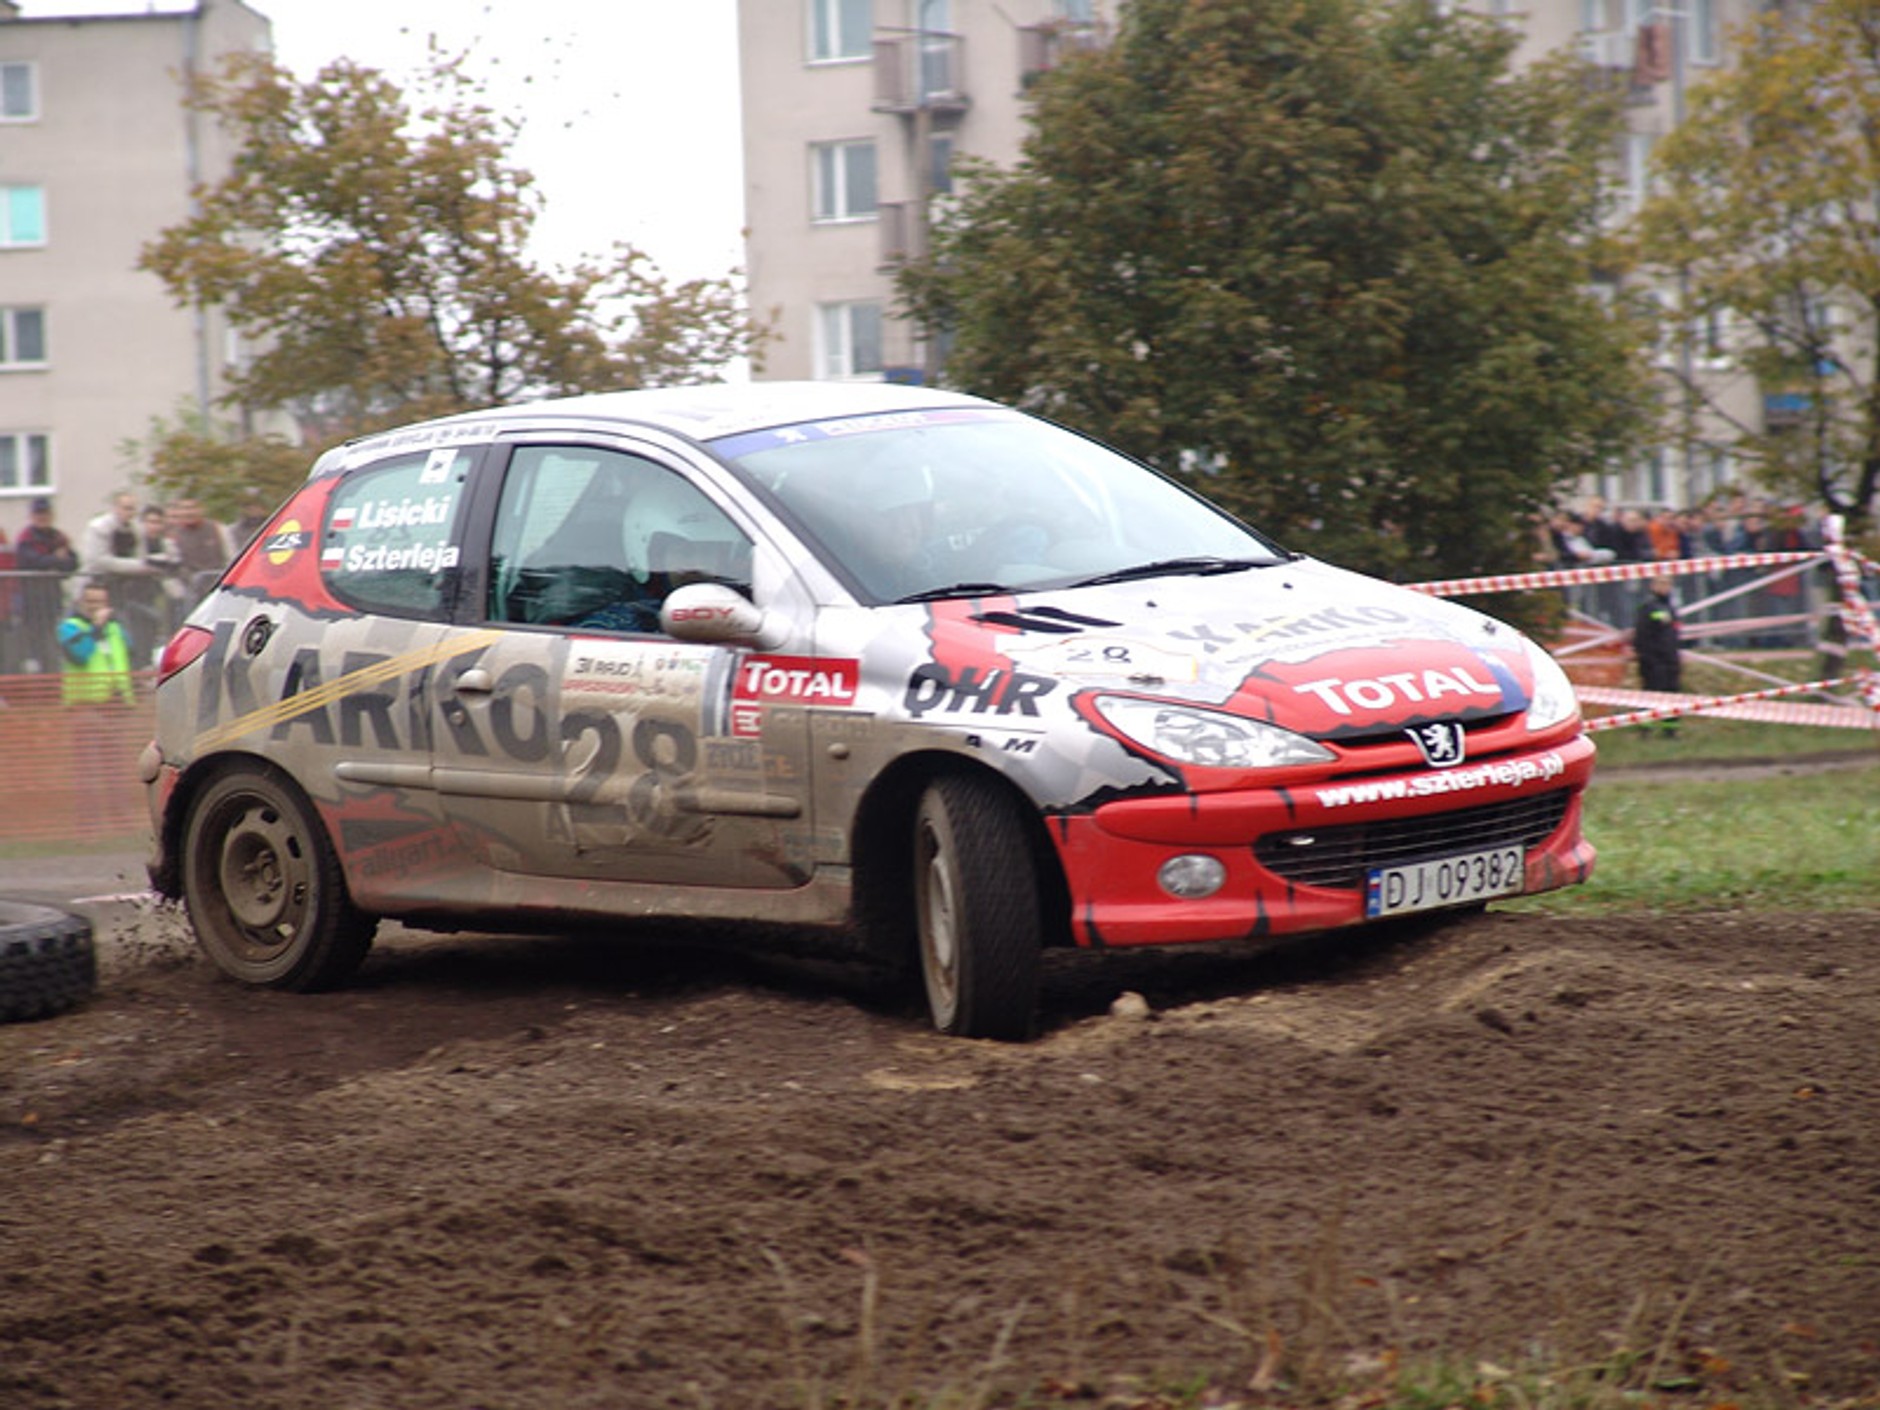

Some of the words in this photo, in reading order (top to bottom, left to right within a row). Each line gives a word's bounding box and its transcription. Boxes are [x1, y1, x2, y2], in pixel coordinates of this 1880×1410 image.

[358, 496, 452, 529] Lisicki
[347, 540, 460, 574] Szterleja
[196, 620, 549, 763] KARKO
[745, 660, 853, 699] TOTAL
[1294, 667, 1503, 716] TOTAL
[560, 706, 712, 842] 28
[1316, 752, 1565, 807] www.szterleja.pl
[1386, 867, 1424, 909] DJ
[1438, 850, 1519, 900] 09382
